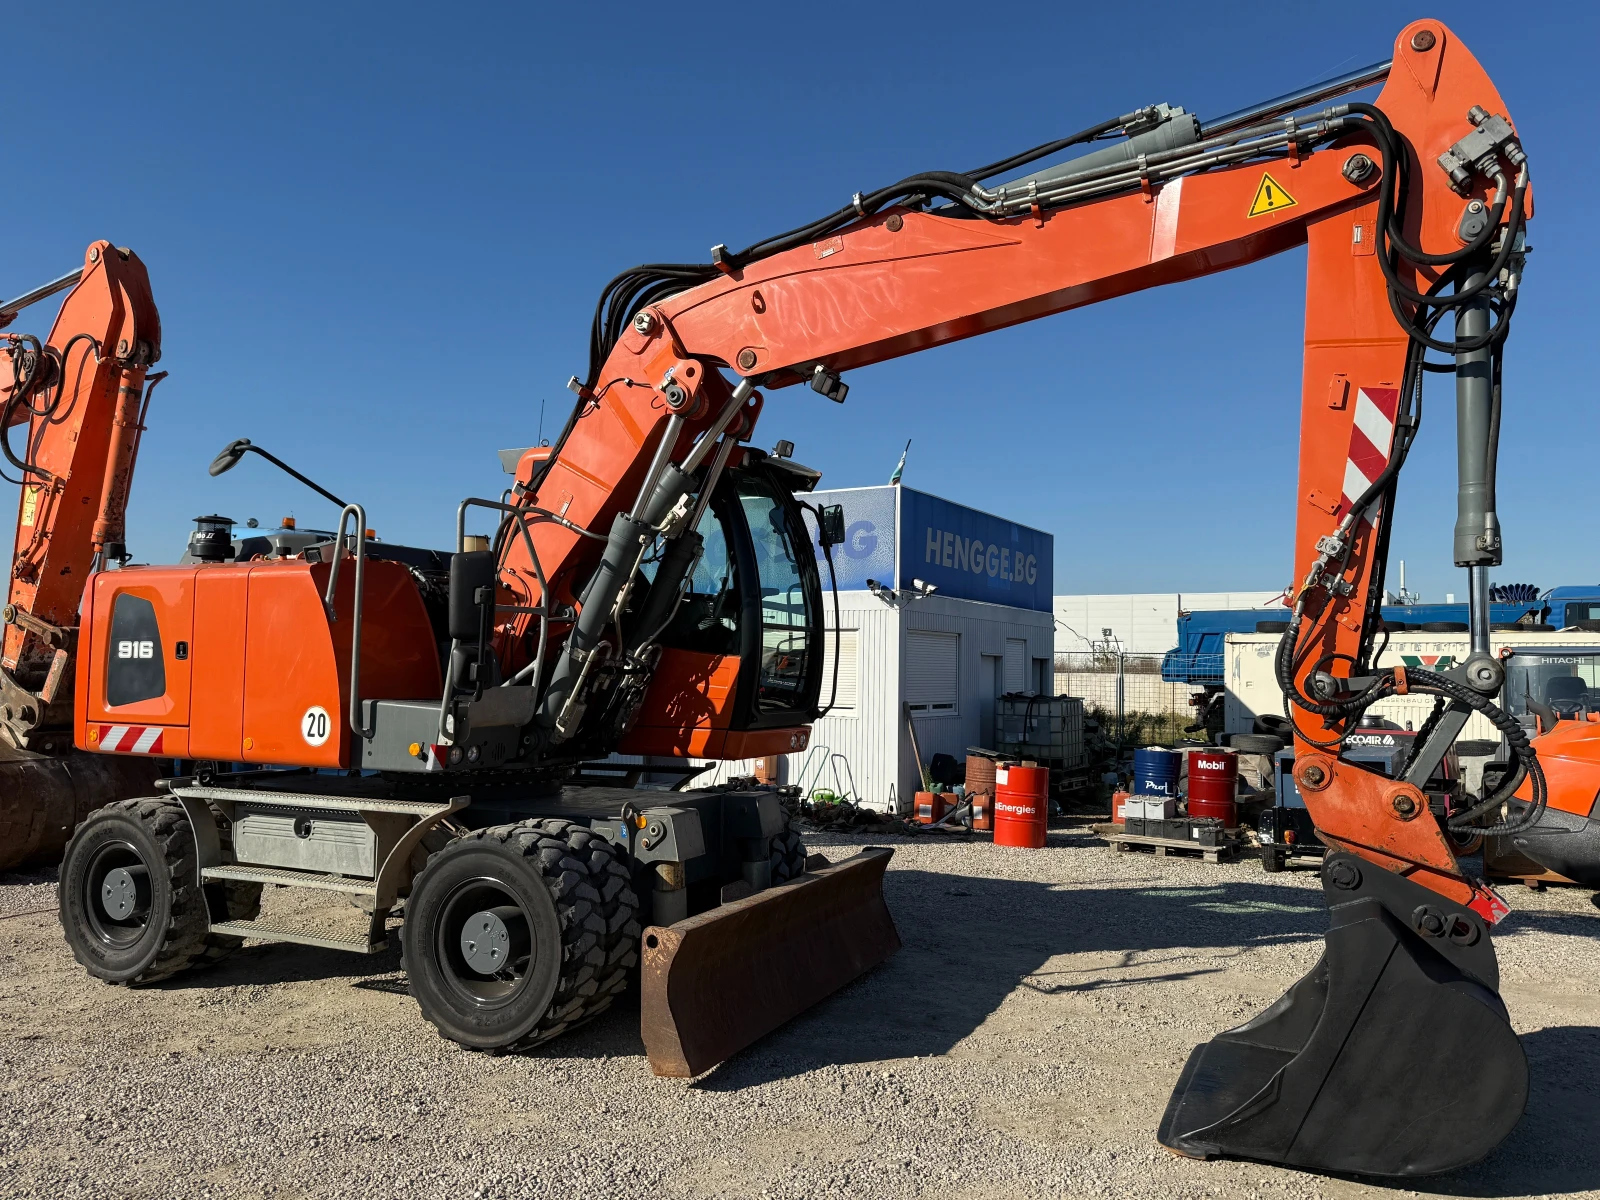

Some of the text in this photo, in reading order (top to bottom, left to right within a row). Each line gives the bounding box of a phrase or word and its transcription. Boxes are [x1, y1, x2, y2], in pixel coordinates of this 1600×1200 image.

[925, 527, 1037, 585] HENGGE.BG
[118, 641, 154, 659] 916
[307, 713, 326, 737] 20
[1197, 760, 1225, 770] Mobil
